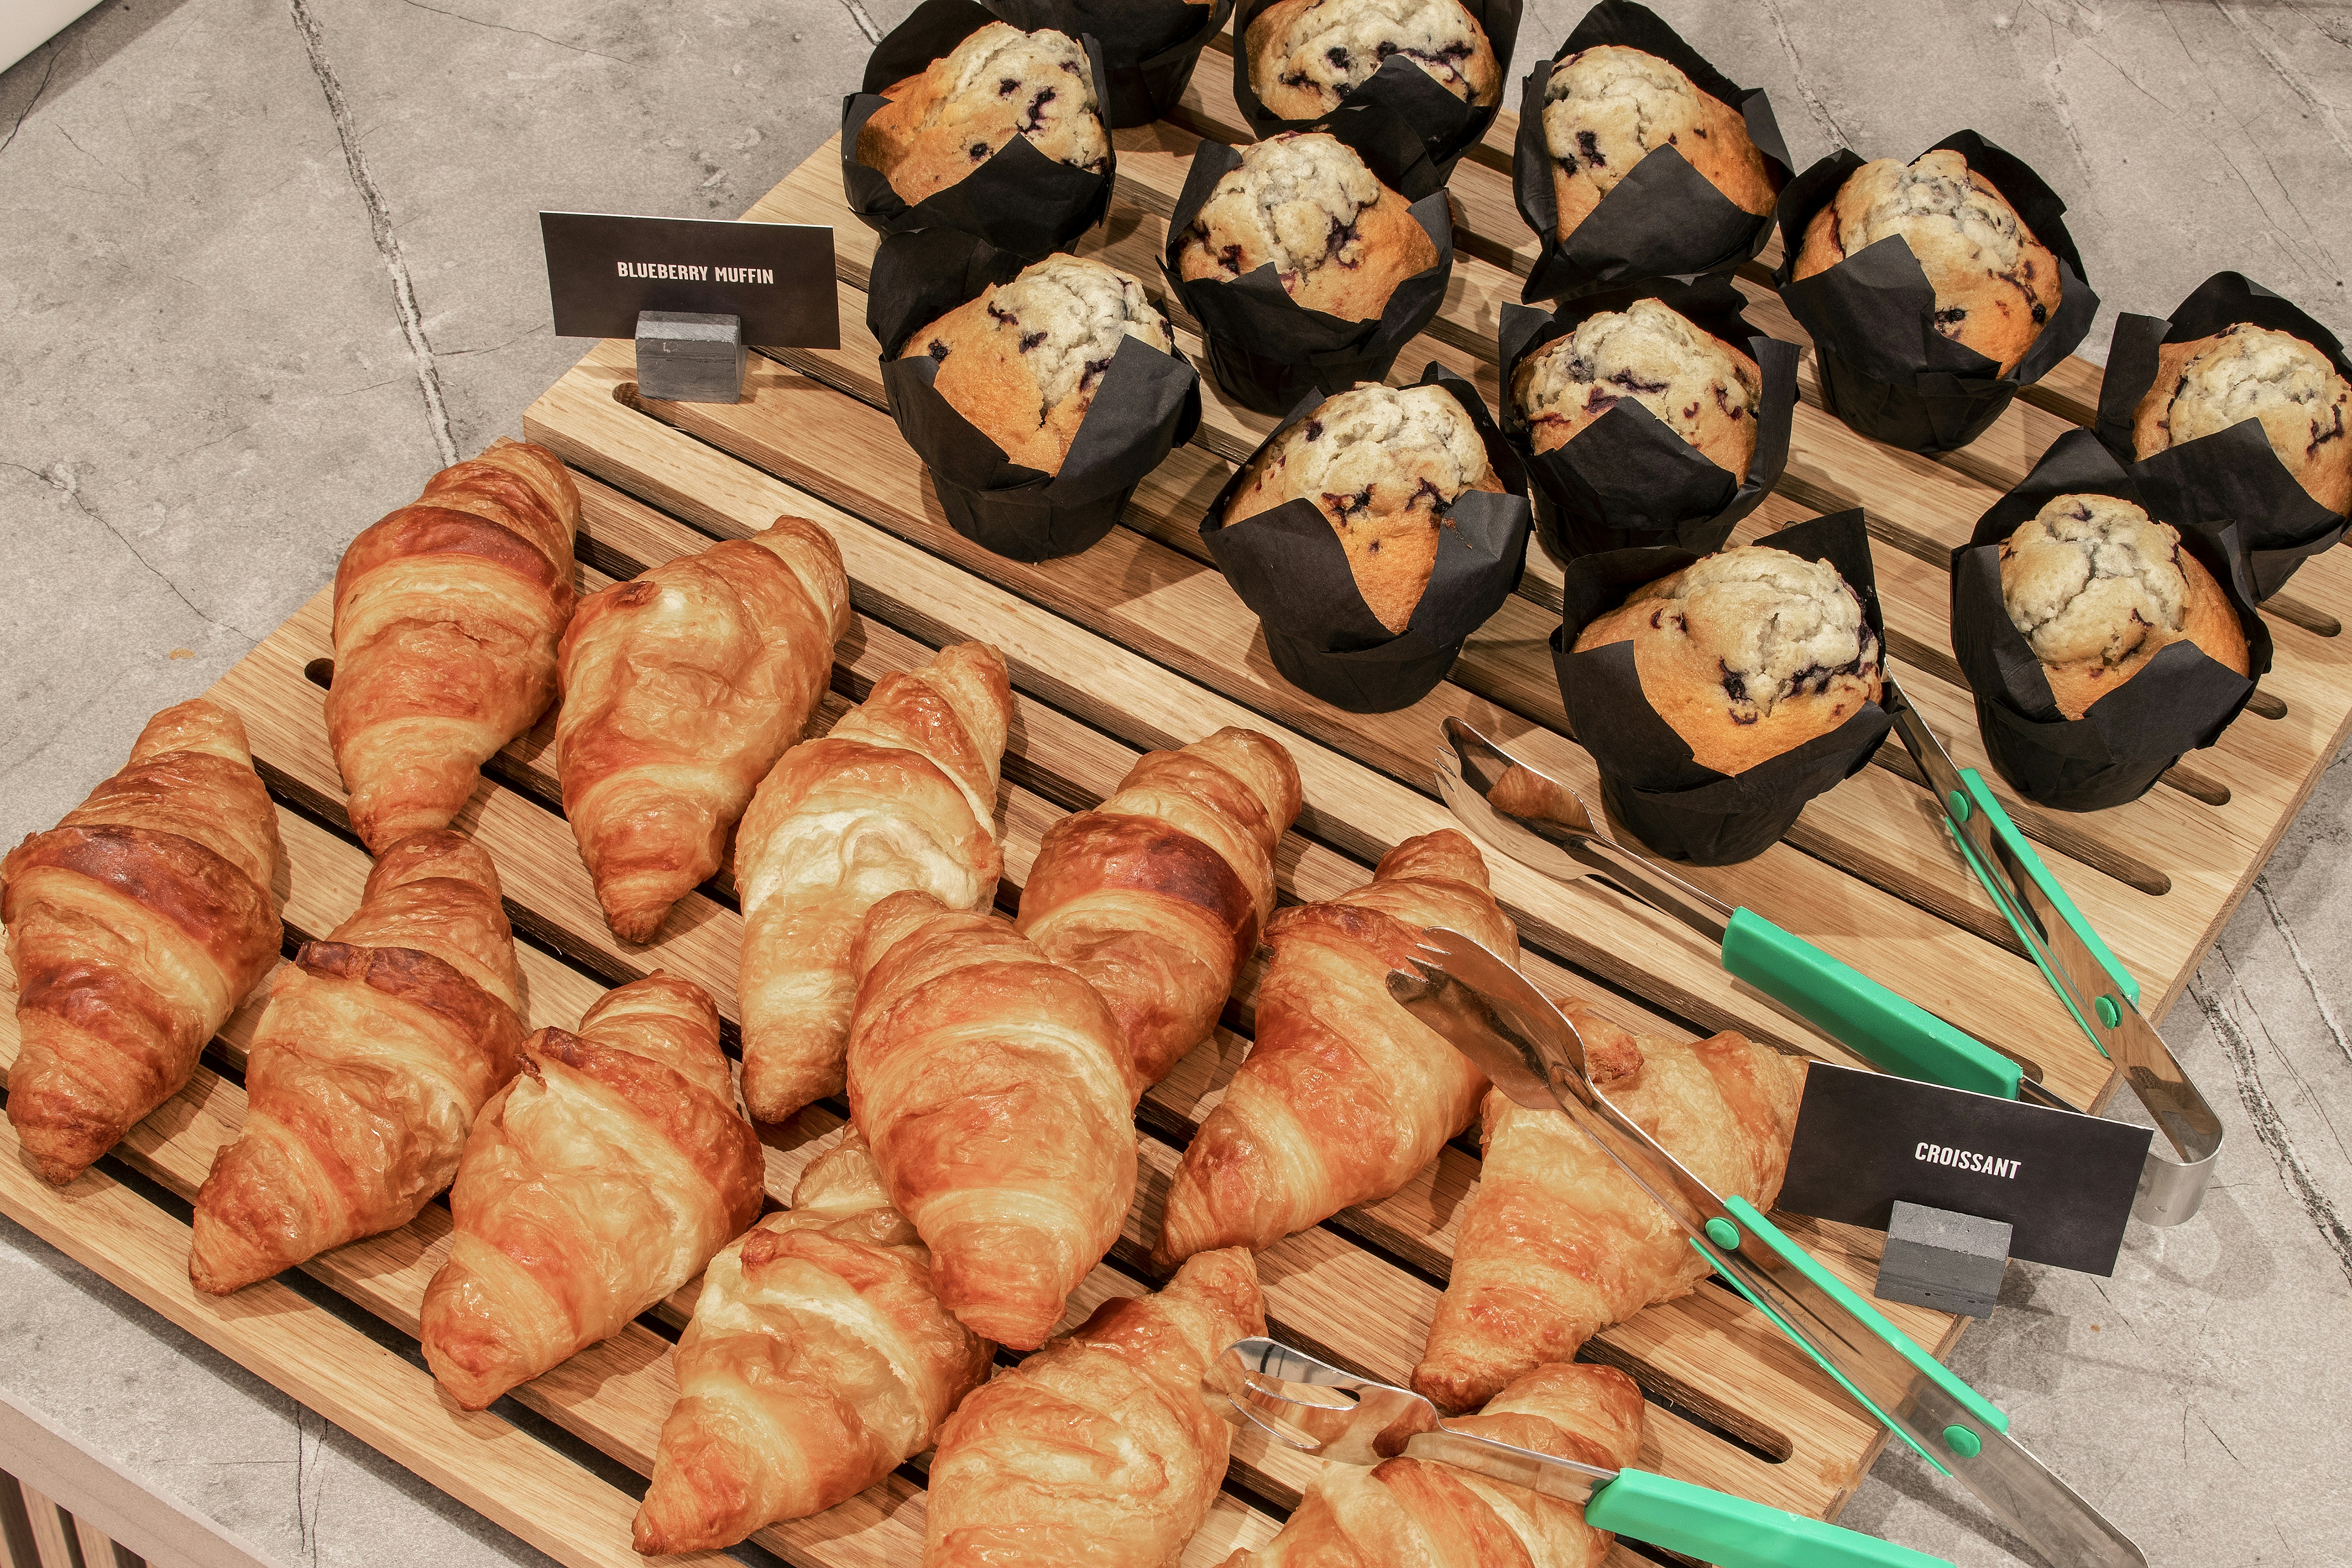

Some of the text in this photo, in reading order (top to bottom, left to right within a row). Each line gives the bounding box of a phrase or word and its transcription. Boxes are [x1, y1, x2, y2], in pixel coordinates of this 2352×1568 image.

[617, 262, 774, 284] BLUEBERRY MUFFIN
[1915, 1142, 2022, 1179] CROISSANT
